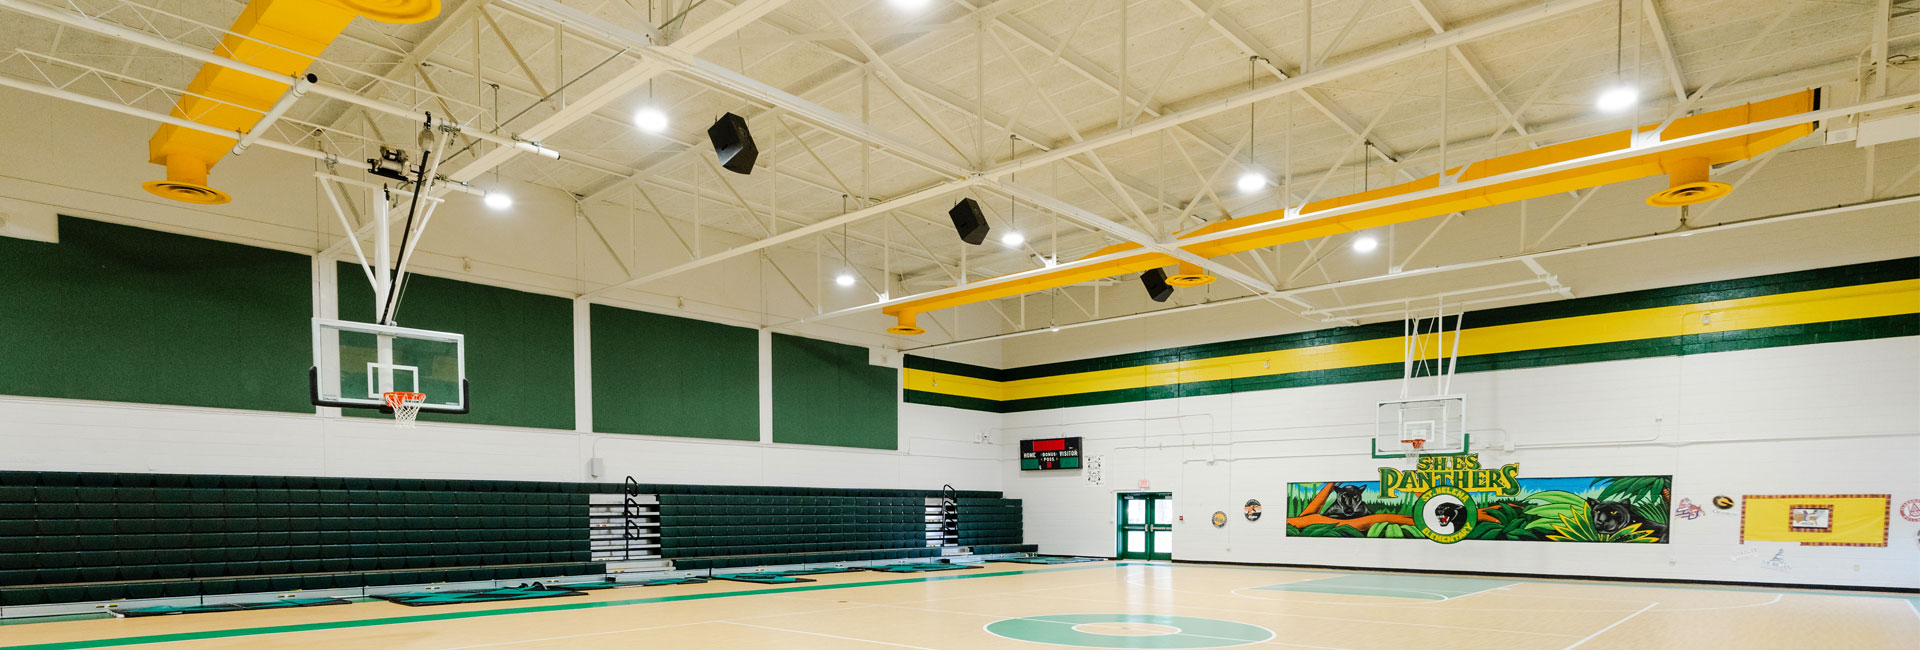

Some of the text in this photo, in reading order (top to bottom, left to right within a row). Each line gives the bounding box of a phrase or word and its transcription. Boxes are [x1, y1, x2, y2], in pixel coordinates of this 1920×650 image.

[1377, 463, 1520, 498] PANTHERS
[1436, 488, 1470, 502] HELENA
[1421, 521, 1473, 544] ELEMENTARY
